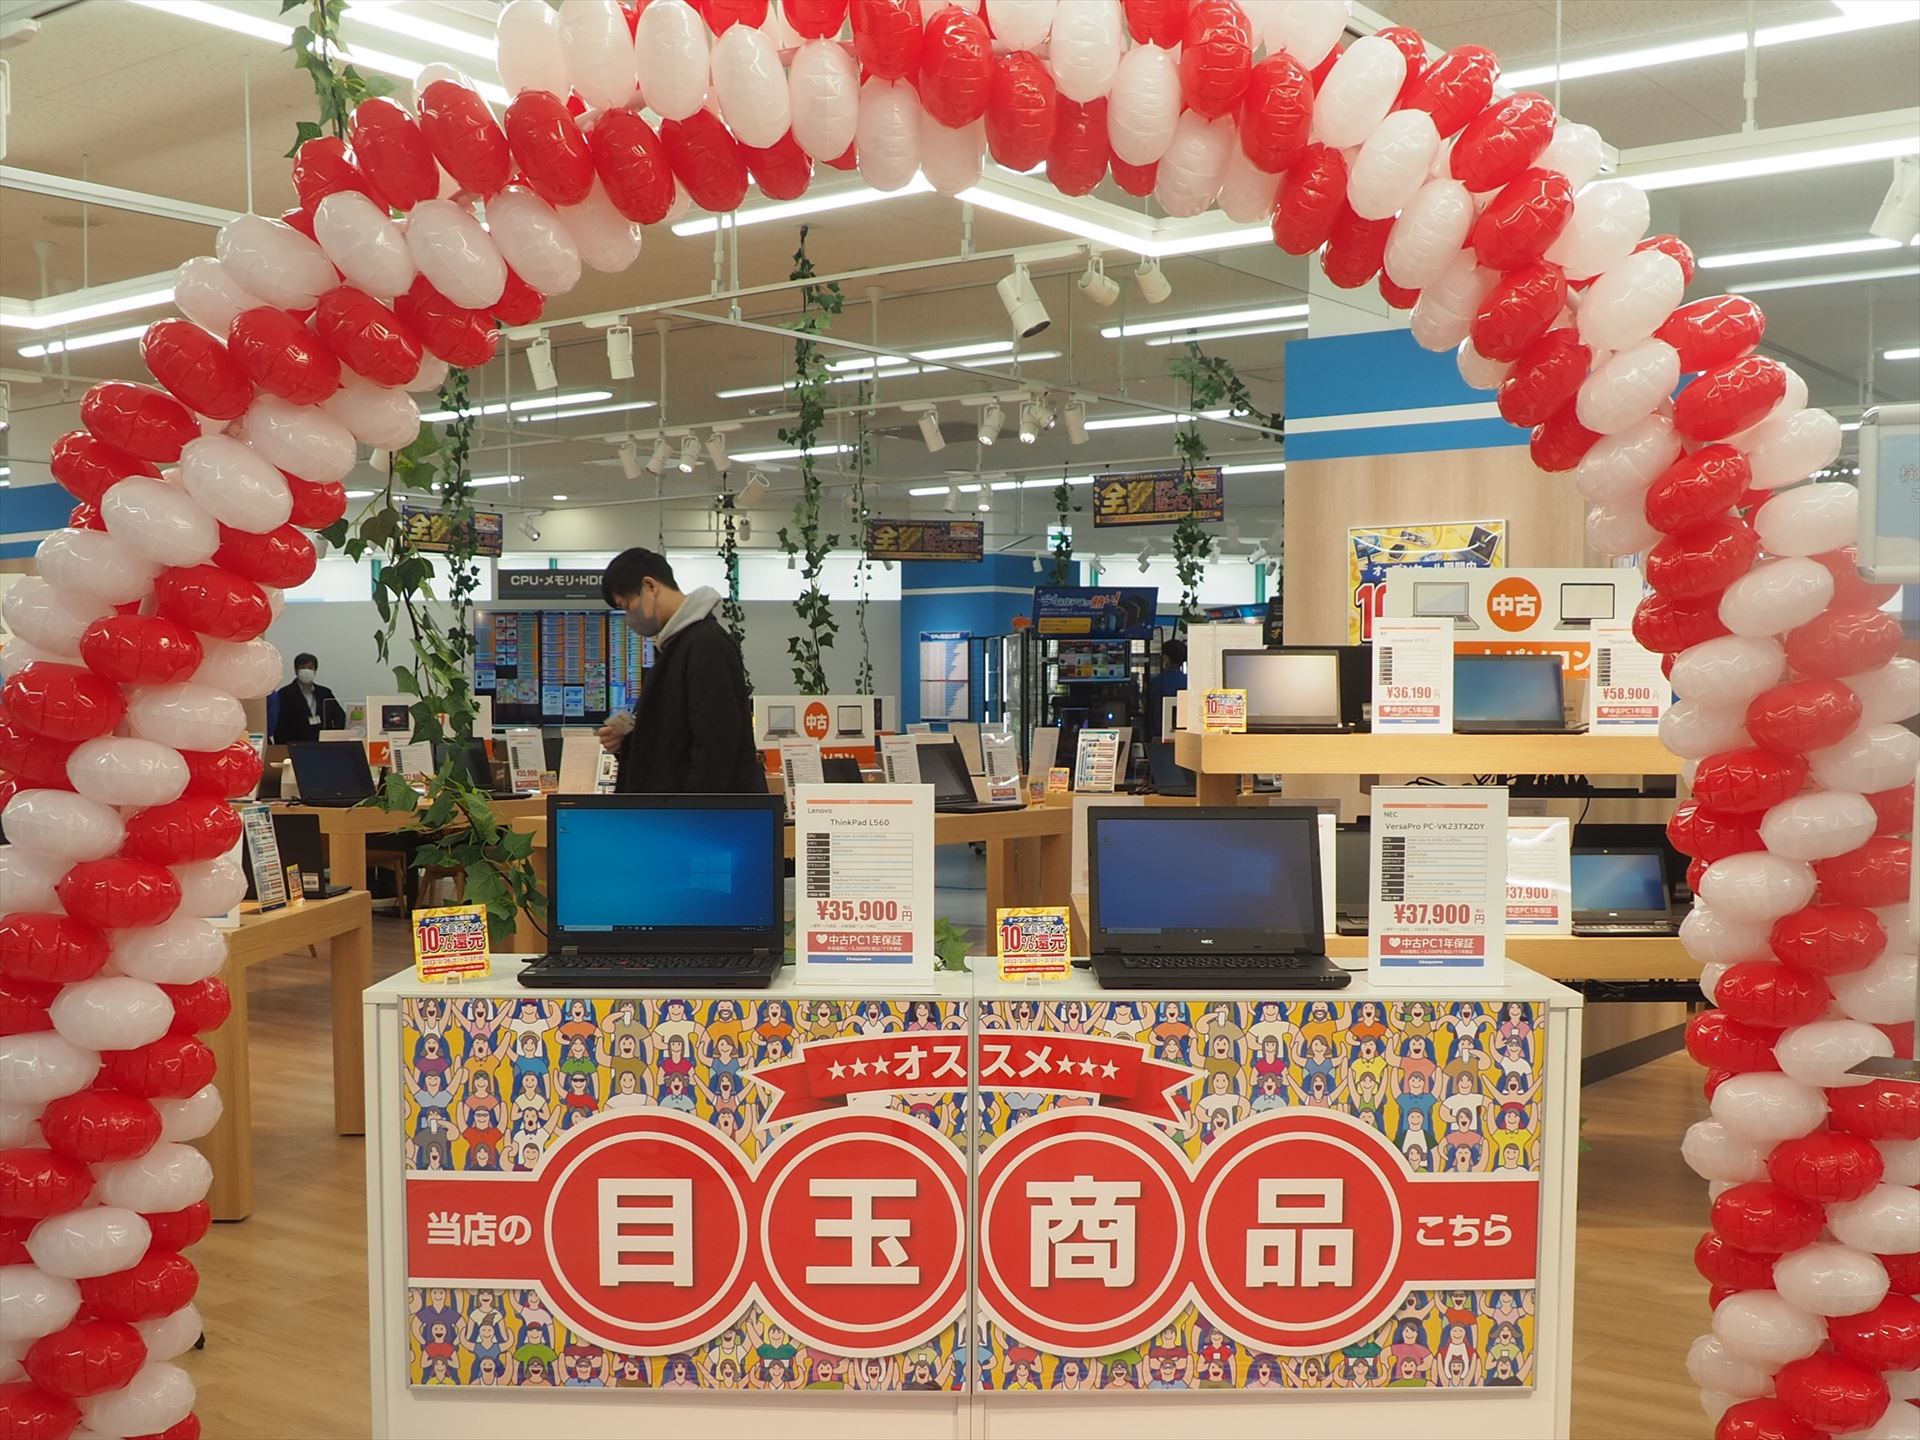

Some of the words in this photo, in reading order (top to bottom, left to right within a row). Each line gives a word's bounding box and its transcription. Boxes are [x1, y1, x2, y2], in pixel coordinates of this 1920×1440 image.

[1491, 594, 1538, 618] 中古
[1387, 686, 1432, 699] ¥36,190
[1602, 687, 1650, 700] ¥58,900
[805, 713, 828, 730] 中古
[830, 818, 867, 827] ThinkPad
[869, 818, 890, 827] L560
[1385, 823, 1422, 831] VersaPro
[817, 900, 897, 922] ¥35,900
[1394, 904, 1470, 925] ¥37,900
[829, 934, 903, 946] 中古PC1年保証
[1401, 938, 1475, 949] 中古PC1年保証
[426, 1211, 532, 1247] 当店の
[1415, 1213, 1513, 1248] こちら
